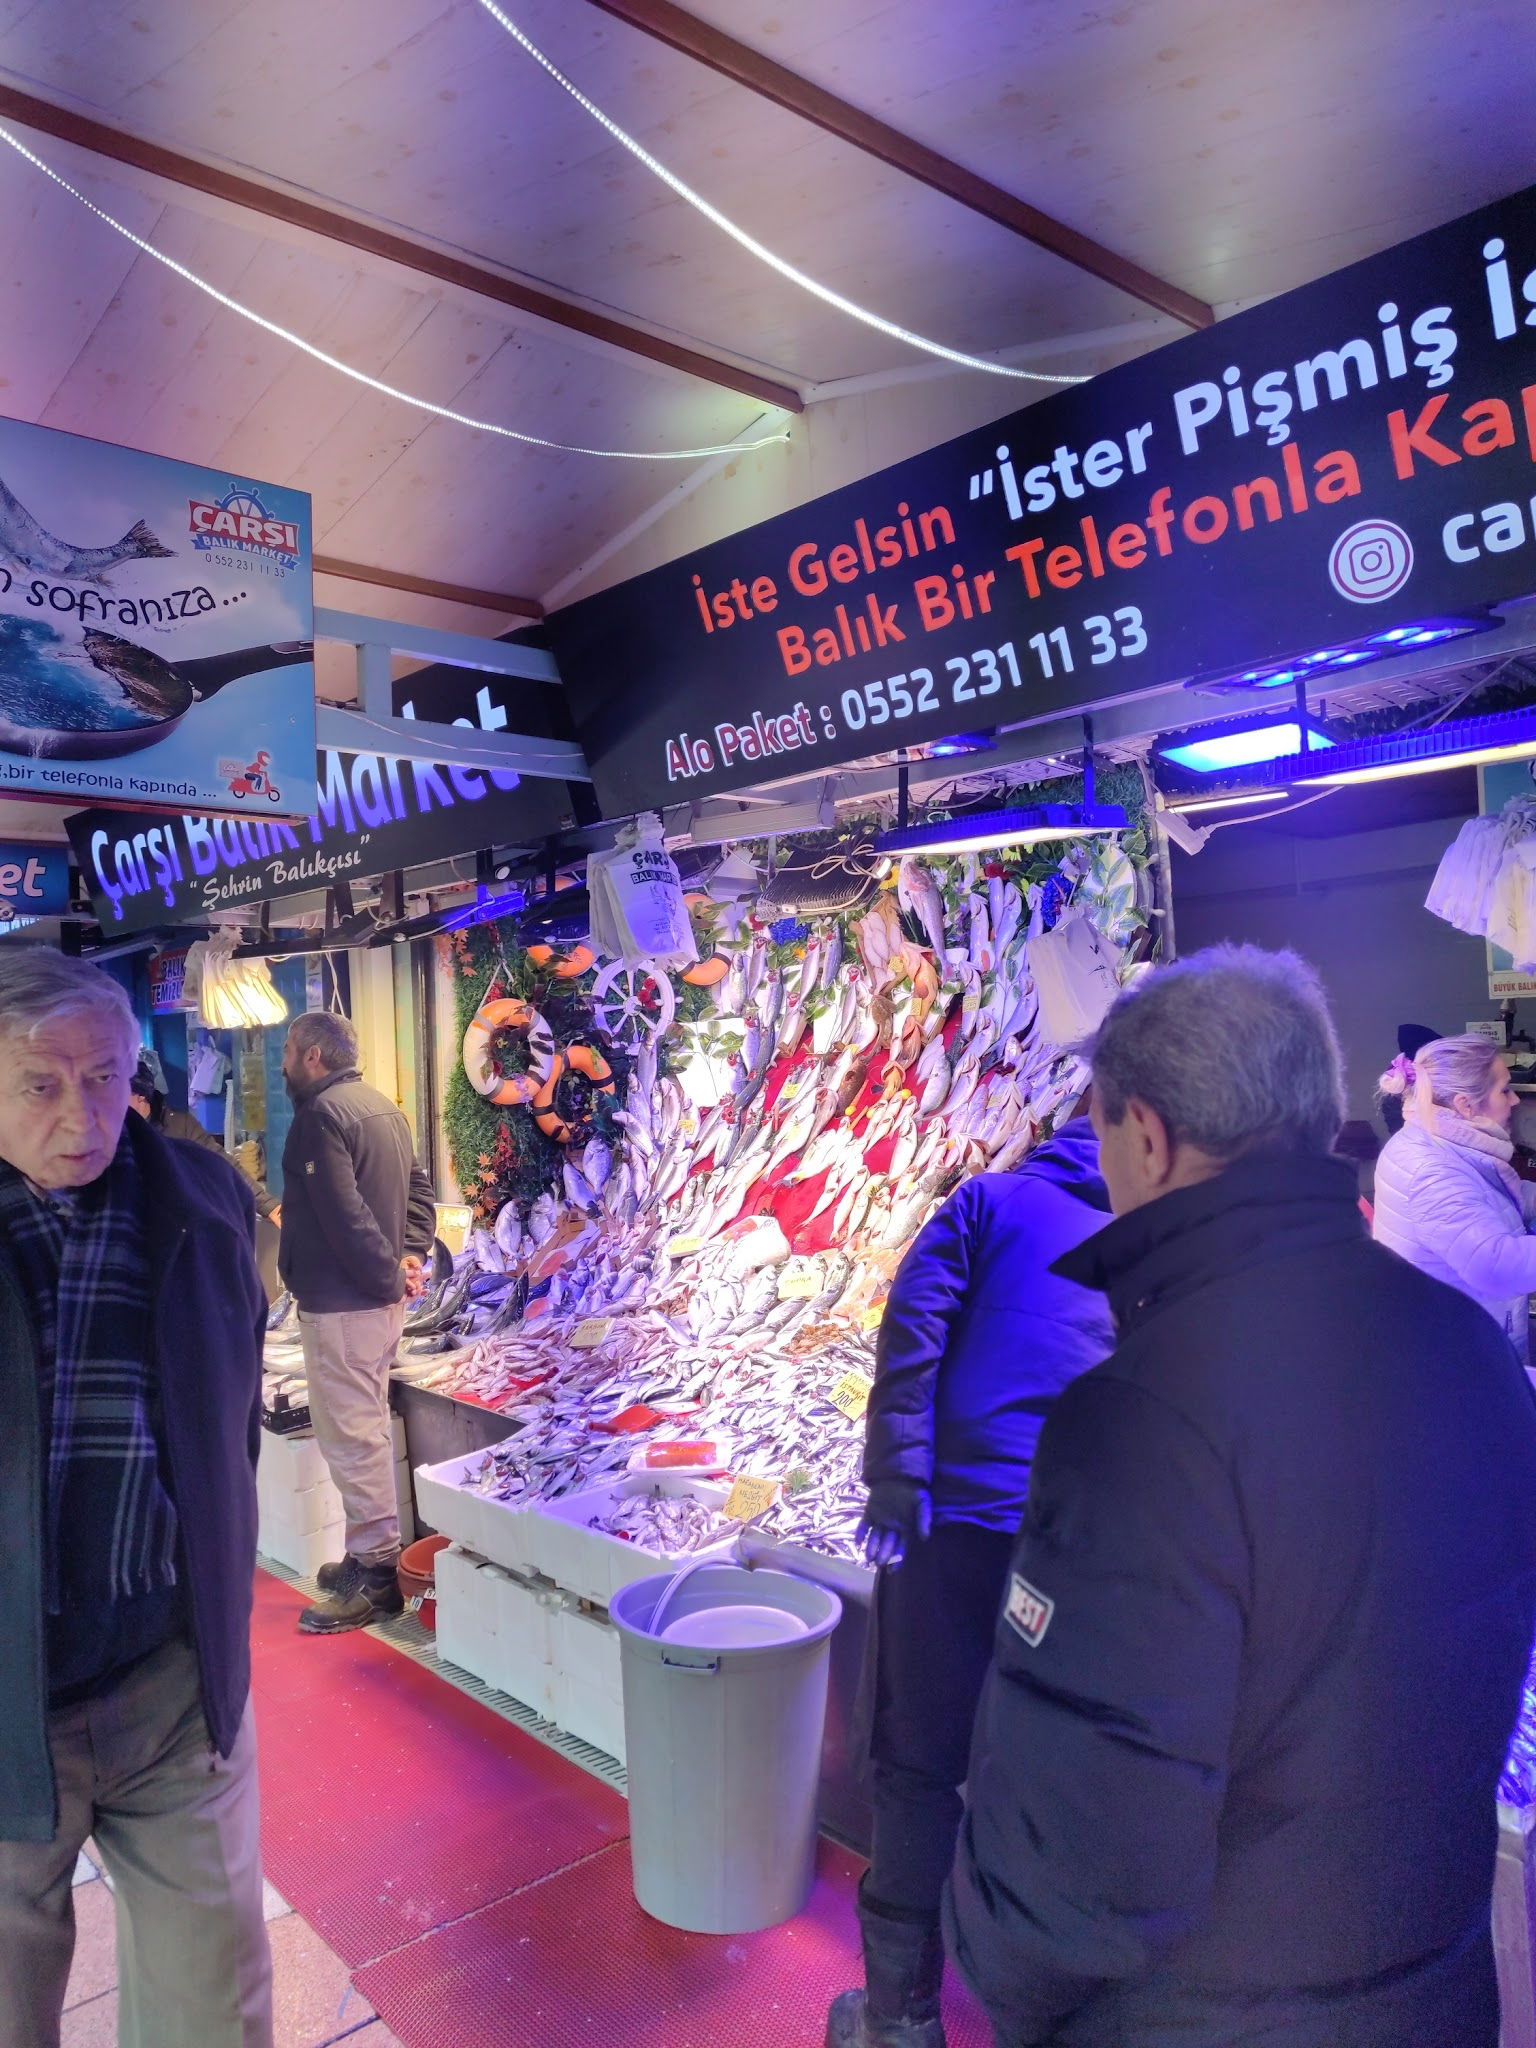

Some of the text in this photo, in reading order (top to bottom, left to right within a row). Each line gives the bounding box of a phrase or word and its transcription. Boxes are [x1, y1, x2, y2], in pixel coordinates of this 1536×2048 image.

[692, 574, 778, 634] İste
[788, 502, 955, 597] Gelsin
[1173, 302, 1458, 455] Pişmiş
[193, 506, 295, 548] ÇARŞI
[203, 535, 291, 563] BALIK MARKET
[1442, 496, 1536, 563] ca
[205, 552, 212, 563] 0
[215, 554, 233, 568] 552
[236, 559, 253, 572] 231
[274, 567, 286, 578] 33
[776, 593, 906, 677] Balık
[914, 565, 995, 632] Bir
[1005, 442, 1361, 599] Telefonla
[666, 732, 716, 782] Alo
[716, 703, 817, 767] Paket
[841, 668, 940, 731] 0552
[945, 641, 1022, 703] 231
[1030, 627, 1074, 678] 11
[1083, 605, 1148, 666] 33
[40, 770, 124, 789] telefonla
[91, 824, 184, 921] Çarşı
[832, 1391, 854, 1408] 200
